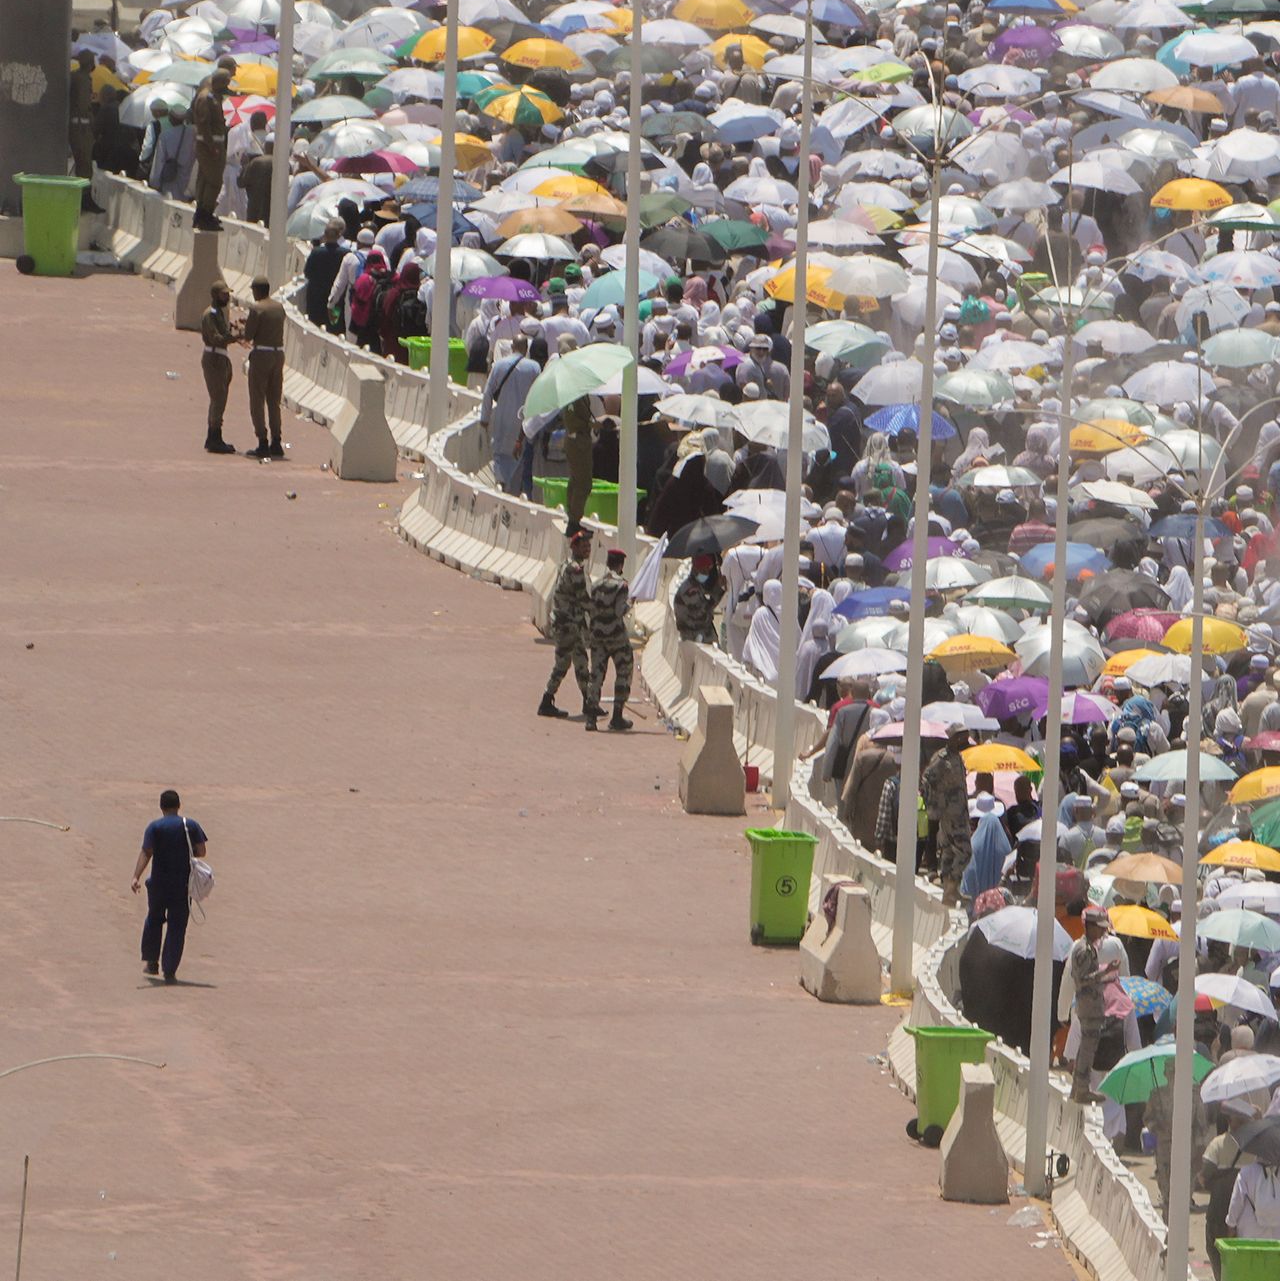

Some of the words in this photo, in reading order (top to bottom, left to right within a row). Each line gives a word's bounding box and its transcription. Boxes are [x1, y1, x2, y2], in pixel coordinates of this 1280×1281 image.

[1008, 697, 1029, 713] stc
[996, 761, 1019, 770] DHL
[781, 879, 792, 894] 5
[1150, 928, 1172, 937] DHL
